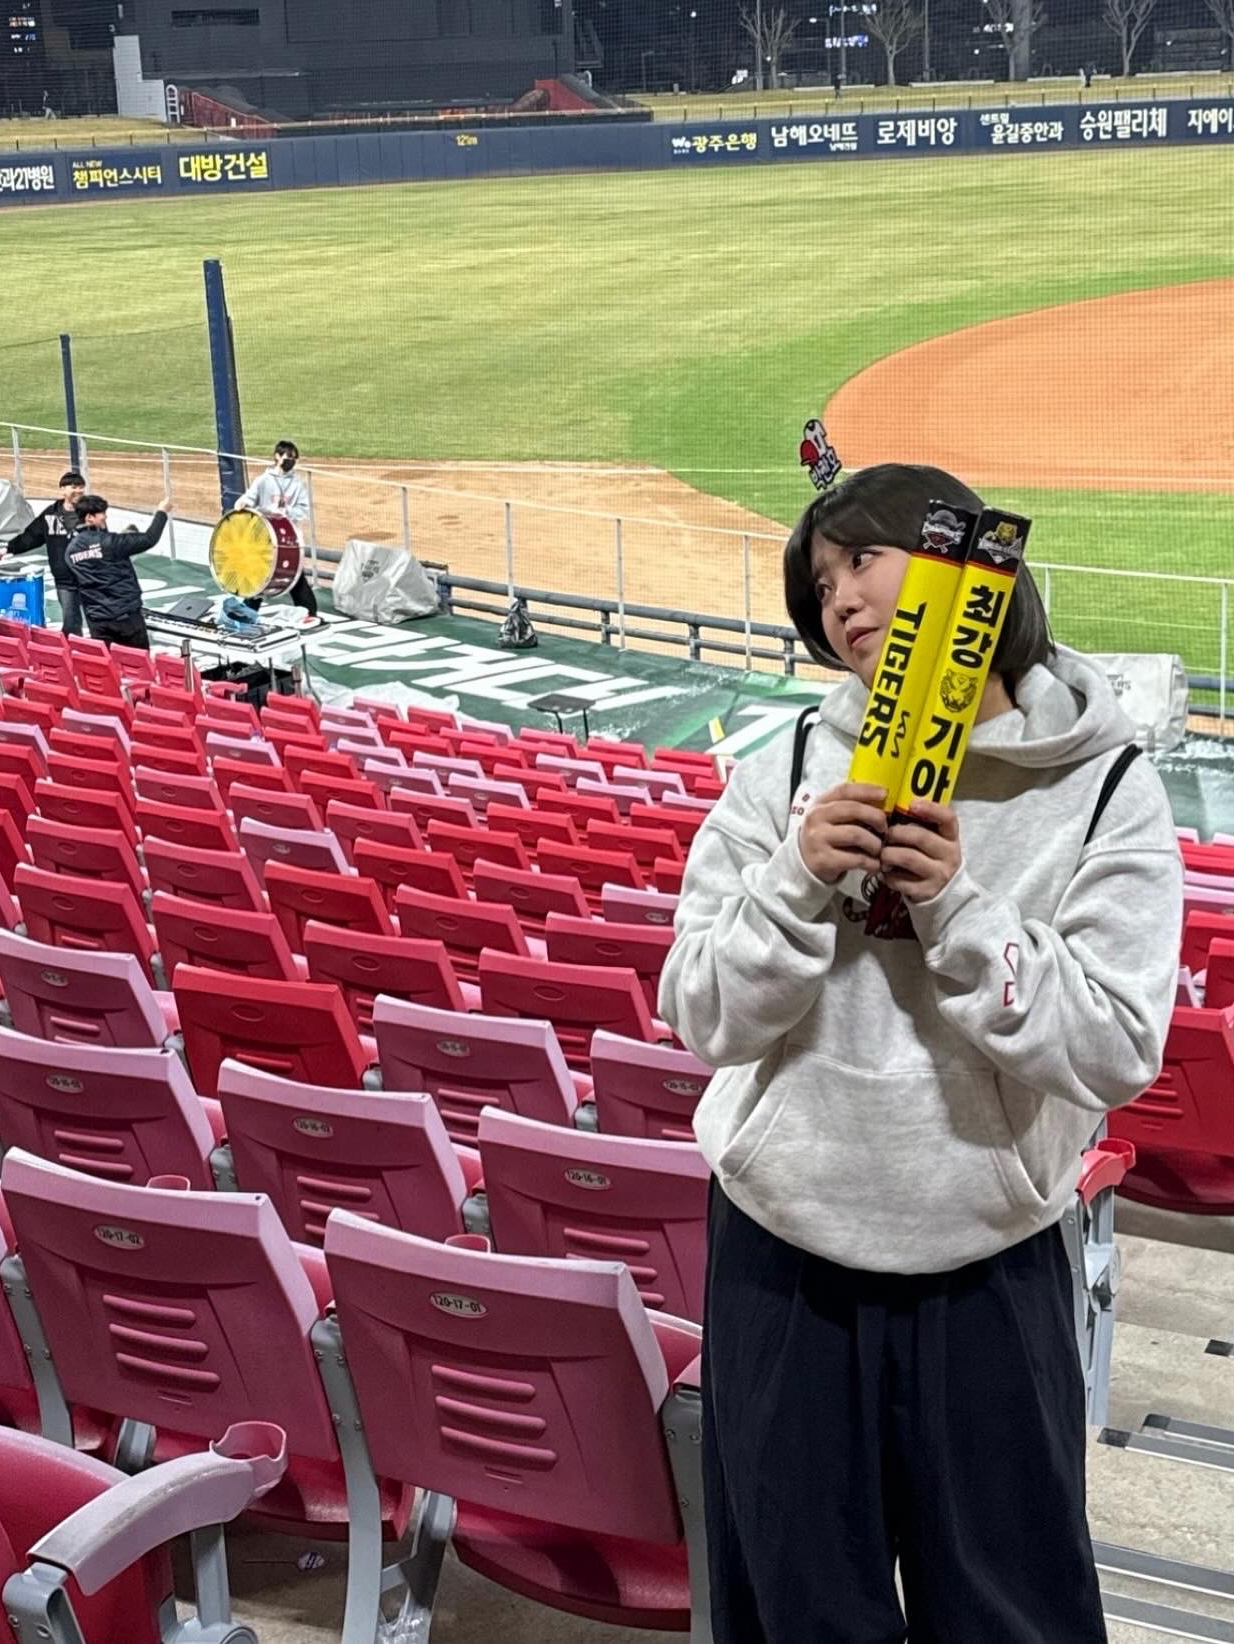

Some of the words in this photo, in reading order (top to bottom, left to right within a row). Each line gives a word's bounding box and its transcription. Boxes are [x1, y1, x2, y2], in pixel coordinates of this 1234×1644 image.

[771, 122, 859, 148] 남해오네뜨
[876, 117, 958, 147] 로제비앙
[1079, 107, 1167, 141] 승원팰리체
[1187, 107, 1234, 134] 지에이
[692, 132, 758, 153] 광주은행
[0, 164, 55, 192] 과21병원
[72, 165, 162, 190] 챔피언스시티
[178, 152, 269, 182] 대방건설
[950, 584, 1006, 669] 최강
[858, 601, 928, 758] TIGERS
[910, 713, 965, 804] 기아
